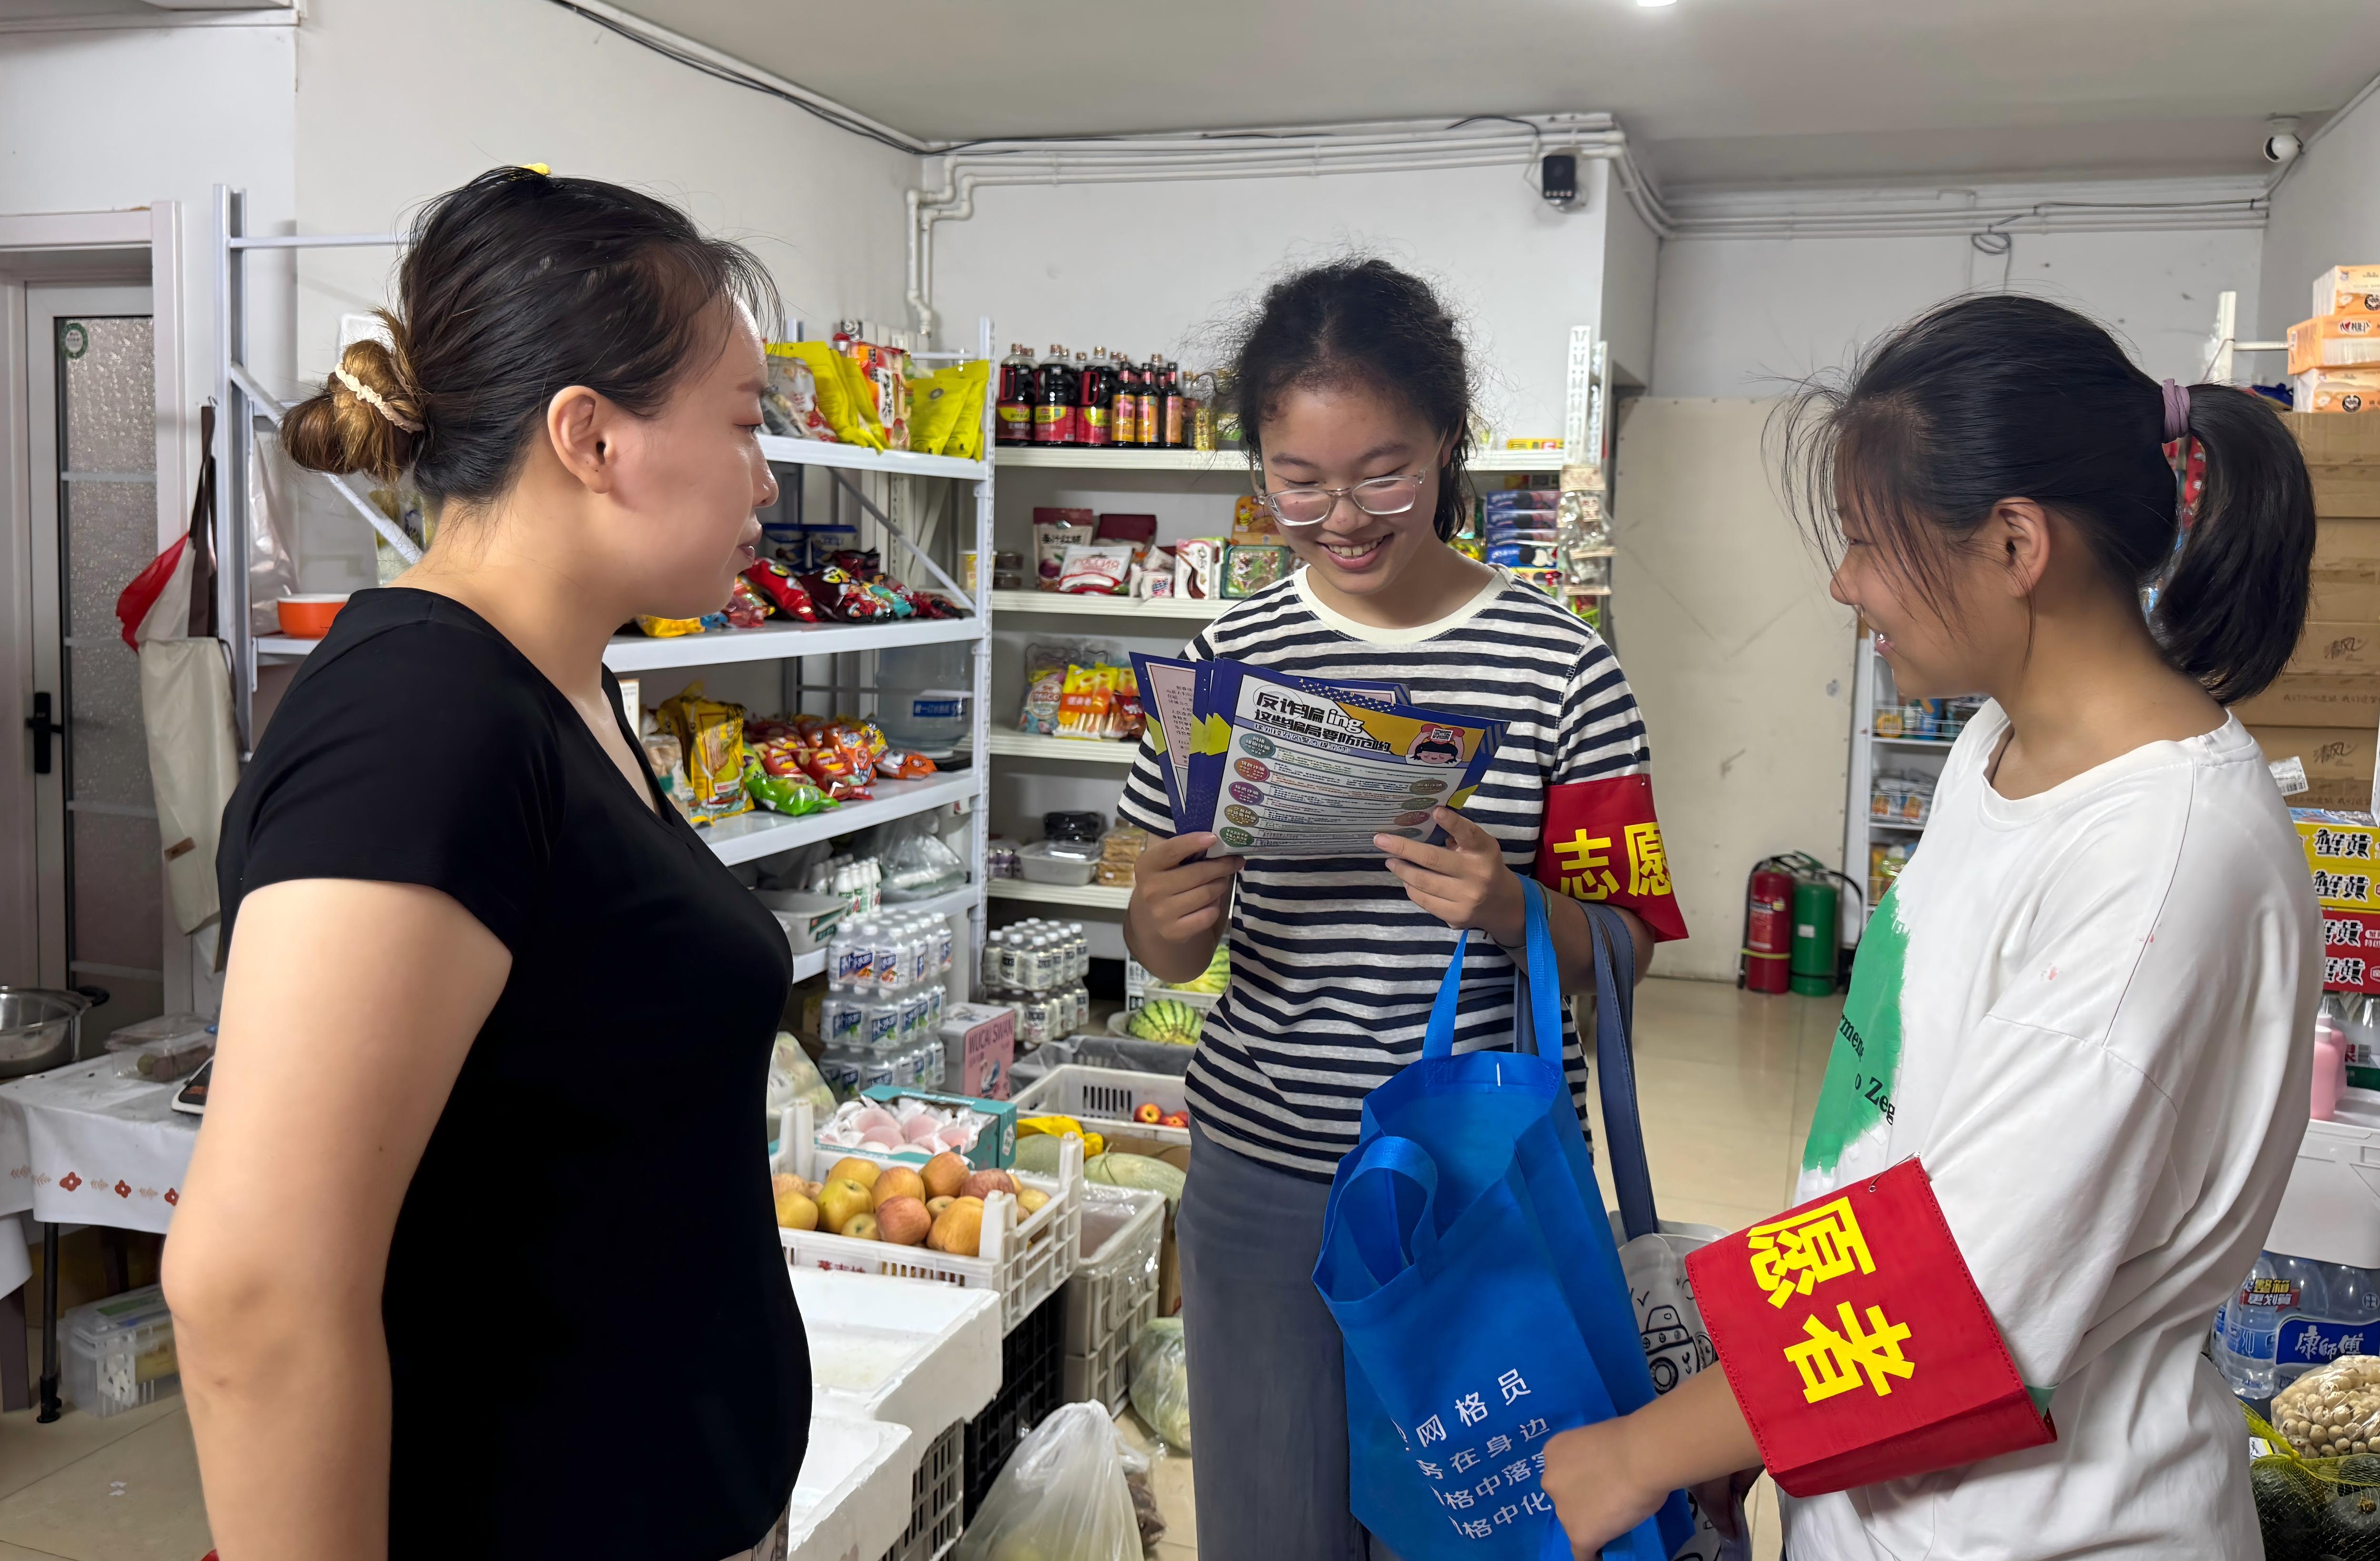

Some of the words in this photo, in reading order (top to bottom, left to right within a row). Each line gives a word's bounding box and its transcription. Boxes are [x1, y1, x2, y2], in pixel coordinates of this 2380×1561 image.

[1256, 692, 1325, 724] 反诈骗
[1327, 708, 1365, 734] ing
[1553, 822, 1672, 900] 志愿
[1746, 1196, 1915, 1403] 愿者
[1391, 1368, 1531, 1452] 网格员
[1429, 1450, 1544, 1510] 格中落
[1448, 1491, 1552, 1539] 格中化
